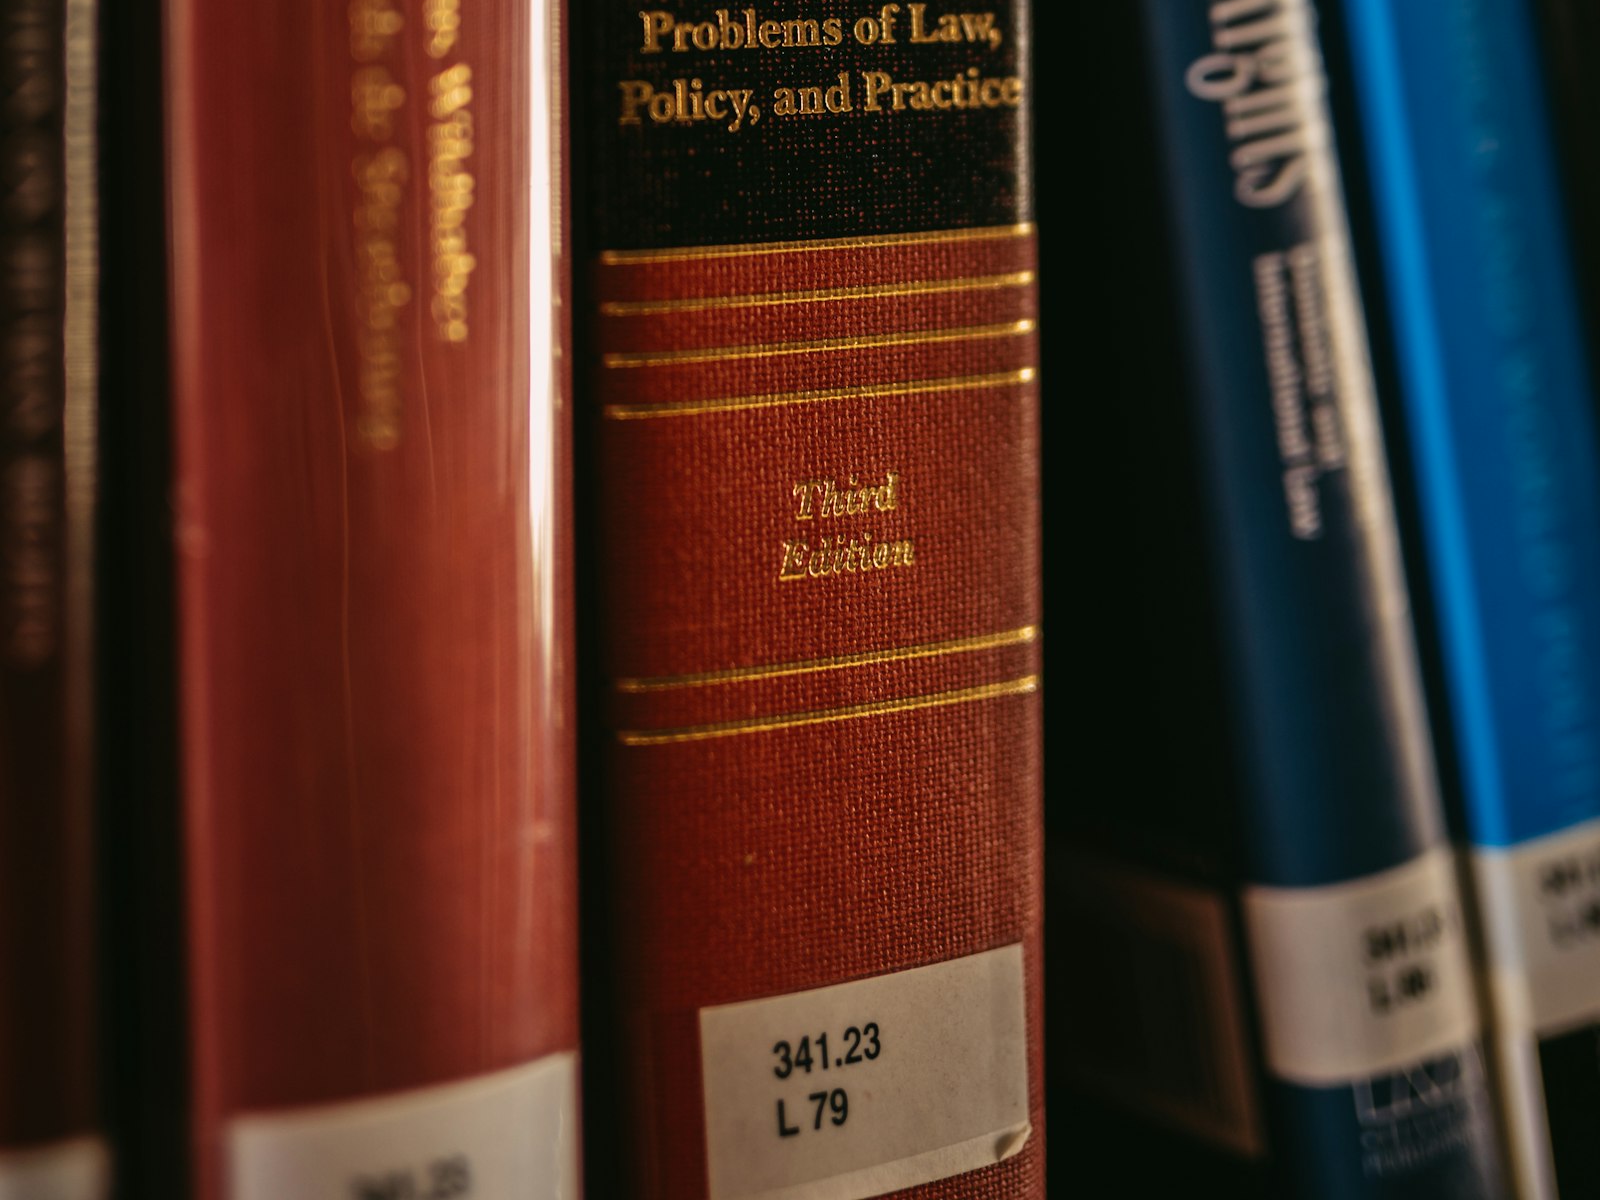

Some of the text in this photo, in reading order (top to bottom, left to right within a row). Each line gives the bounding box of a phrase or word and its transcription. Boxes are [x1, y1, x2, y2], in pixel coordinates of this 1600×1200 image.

[639, 2, 1001, 54] Problems of Law,
[618, 67, 1024, 133] Policy, and Practice
[793, 471, 899, 521] Third
[779, 531, 915, 582] Edition
[773, 1021, 881, 1080] 341.23
[777, 1087, 848, 1138] L 79
